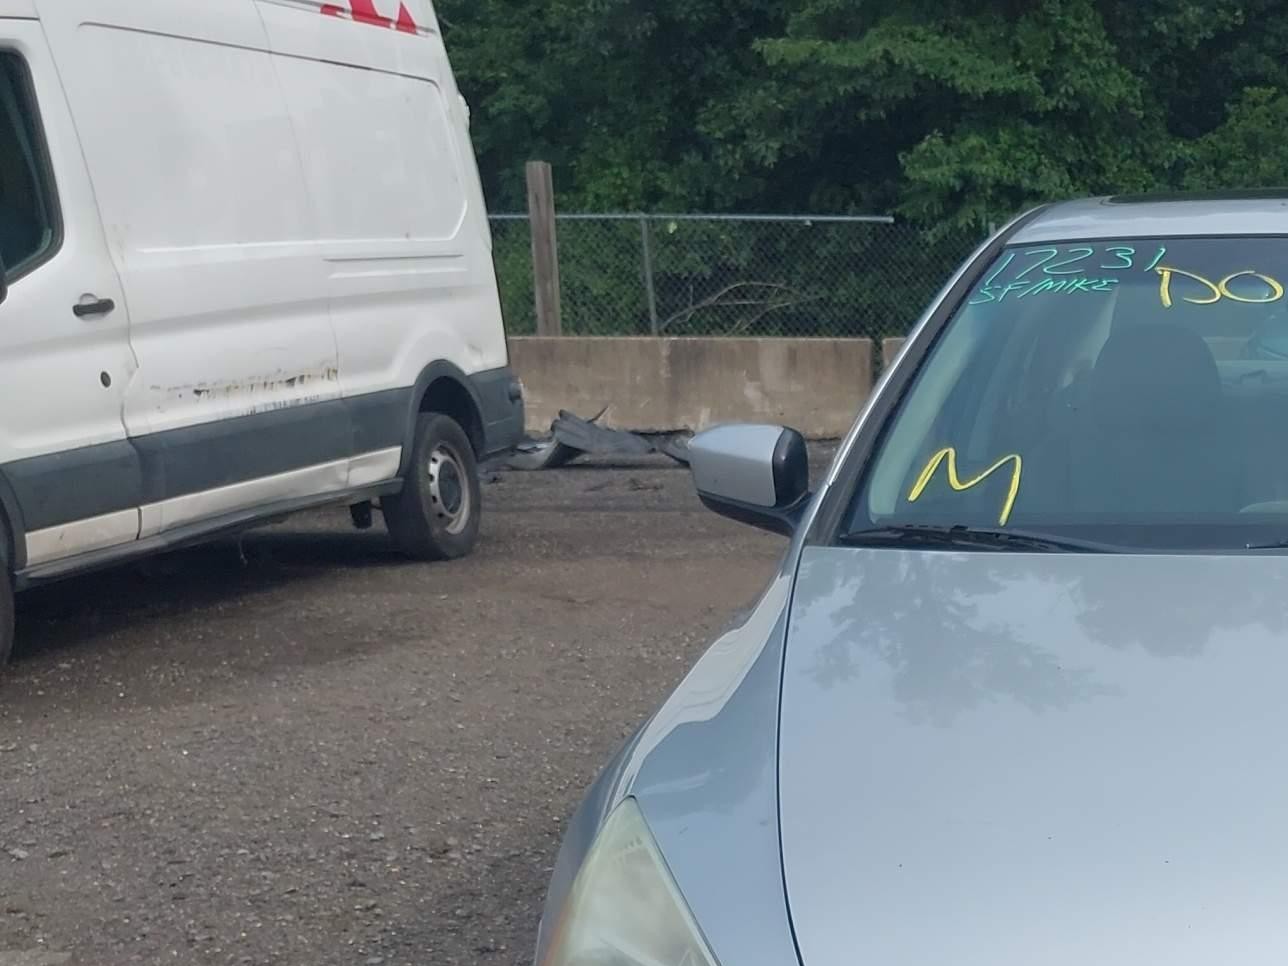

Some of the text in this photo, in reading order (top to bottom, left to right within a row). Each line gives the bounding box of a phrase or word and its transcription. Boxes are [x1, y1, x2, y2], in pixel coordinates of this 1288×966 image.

[985, 246, 1166, 286] 17231
[1154, 265, 1285, 308] DO
[907, 447, 1023, 528] M
